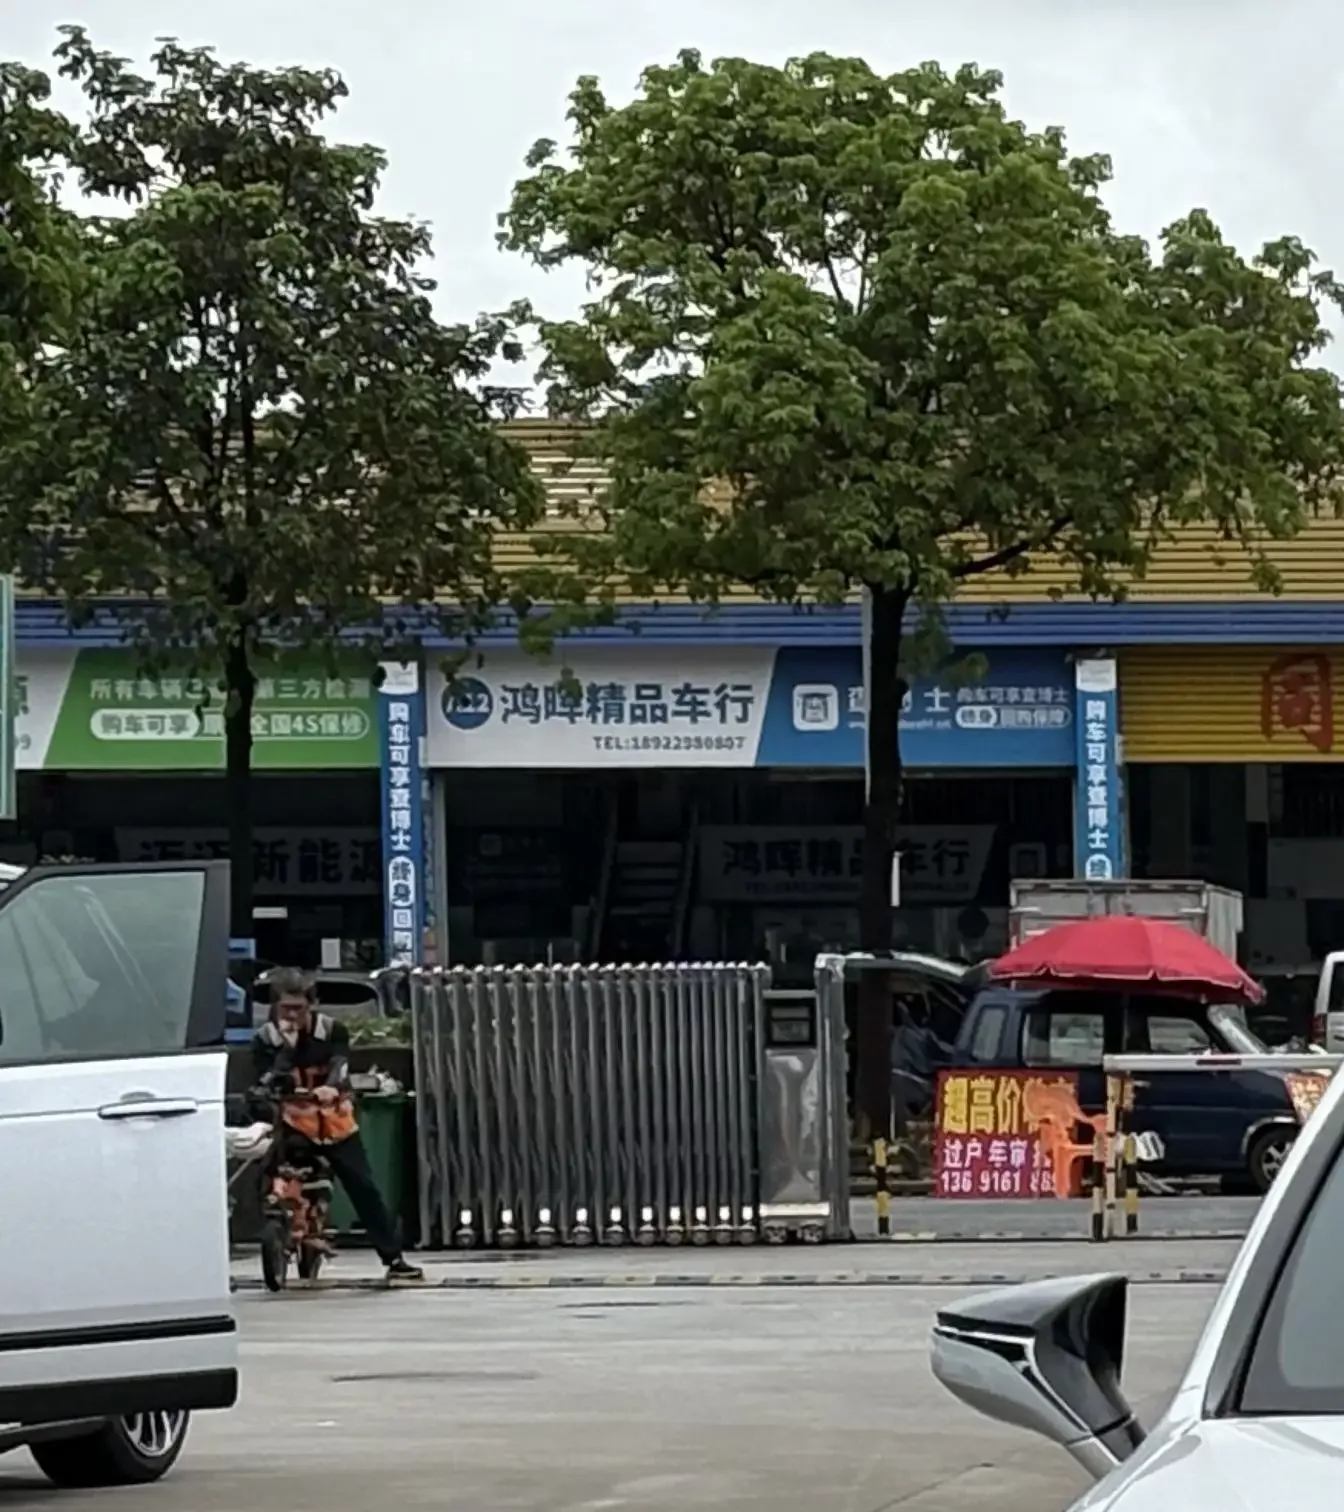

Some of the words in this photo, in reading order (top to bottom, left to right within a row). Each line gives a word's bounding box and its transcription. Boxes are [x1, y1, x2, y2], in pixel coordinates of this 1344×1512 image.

[501, 683, 754, 725] 鸿晖精品车行
